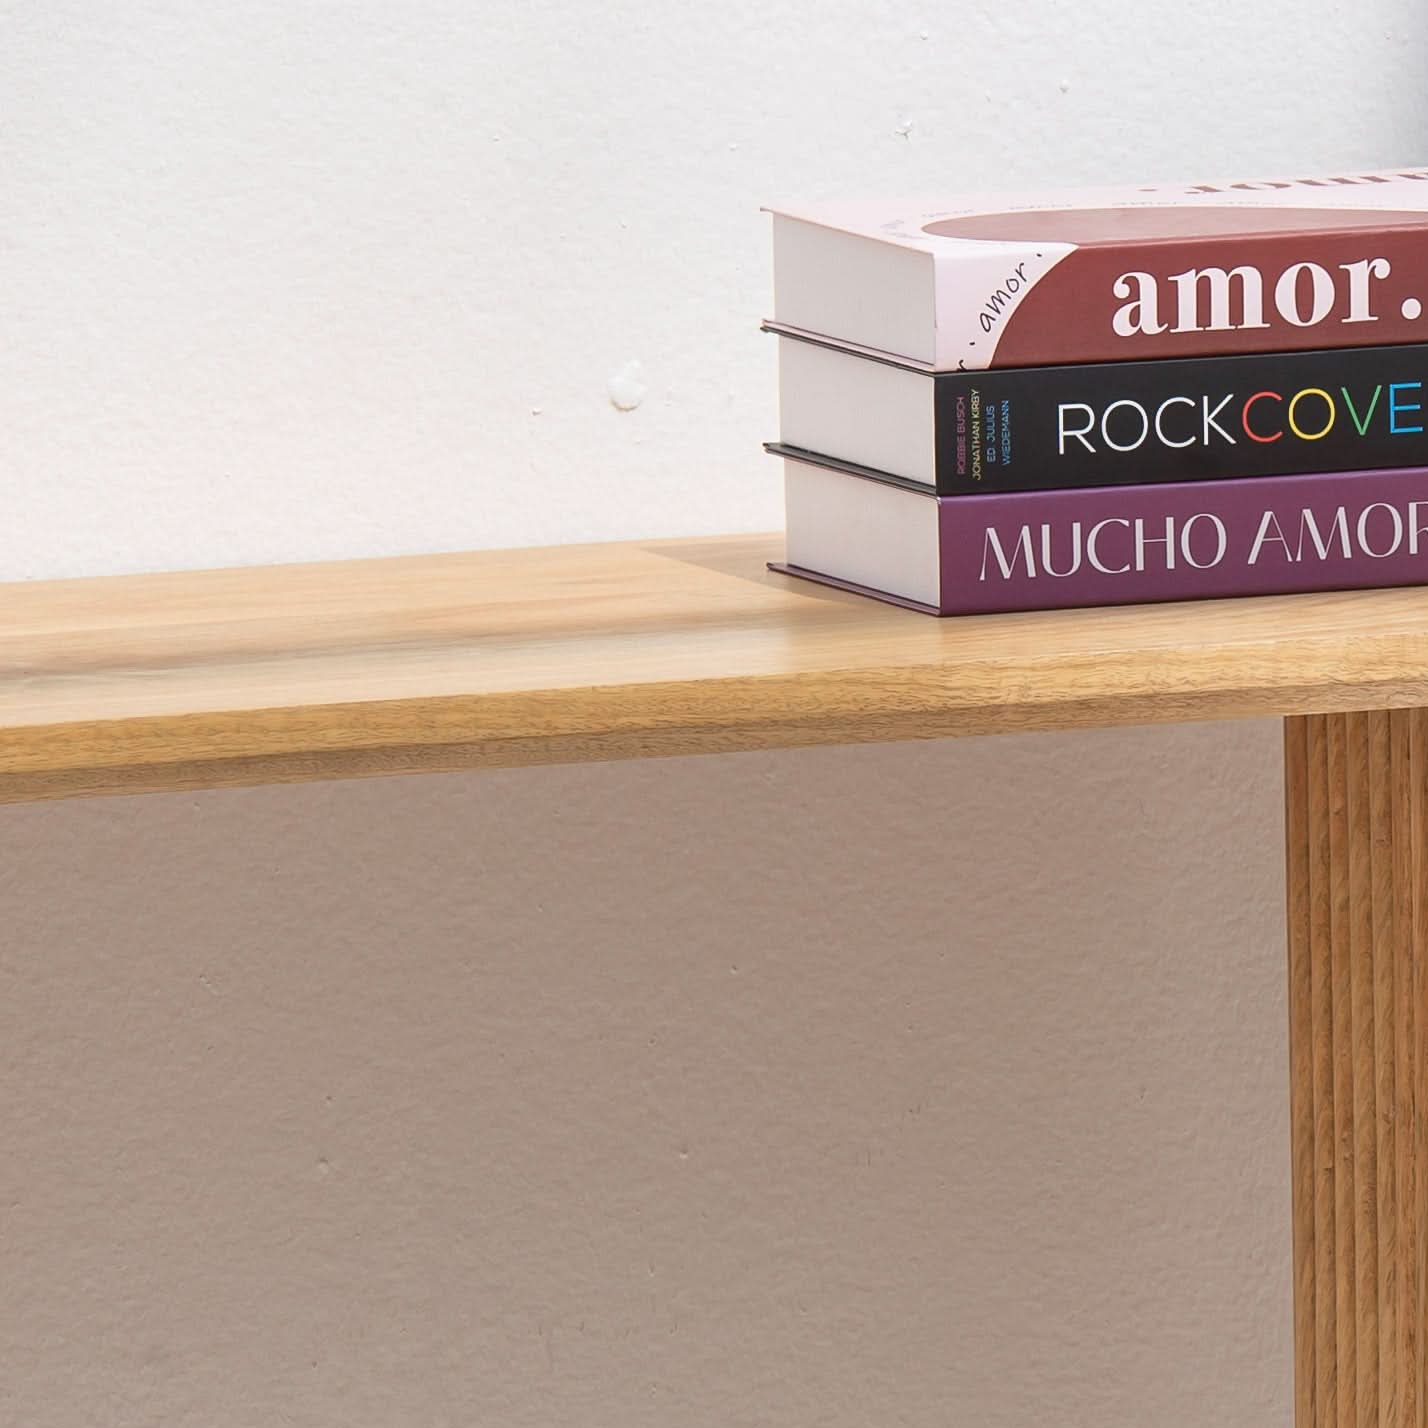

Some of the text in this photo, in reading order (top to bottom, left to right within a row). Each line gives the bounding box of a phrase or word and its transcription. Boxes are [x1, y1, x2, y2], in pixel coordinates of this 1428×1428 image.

[979, 262, 1027, 333] amor
[1111, 256, 1423, 338] amor.
[956, 396, 966, 433] BUSCH
[971, 388, 981, 481] JONATHAN KIRBY
[986, 405, 996, 442] JULIUS
[1001, 400, 1011, 466] WIEDEMANN
[979, 512, 1228, 582] MUCHO
